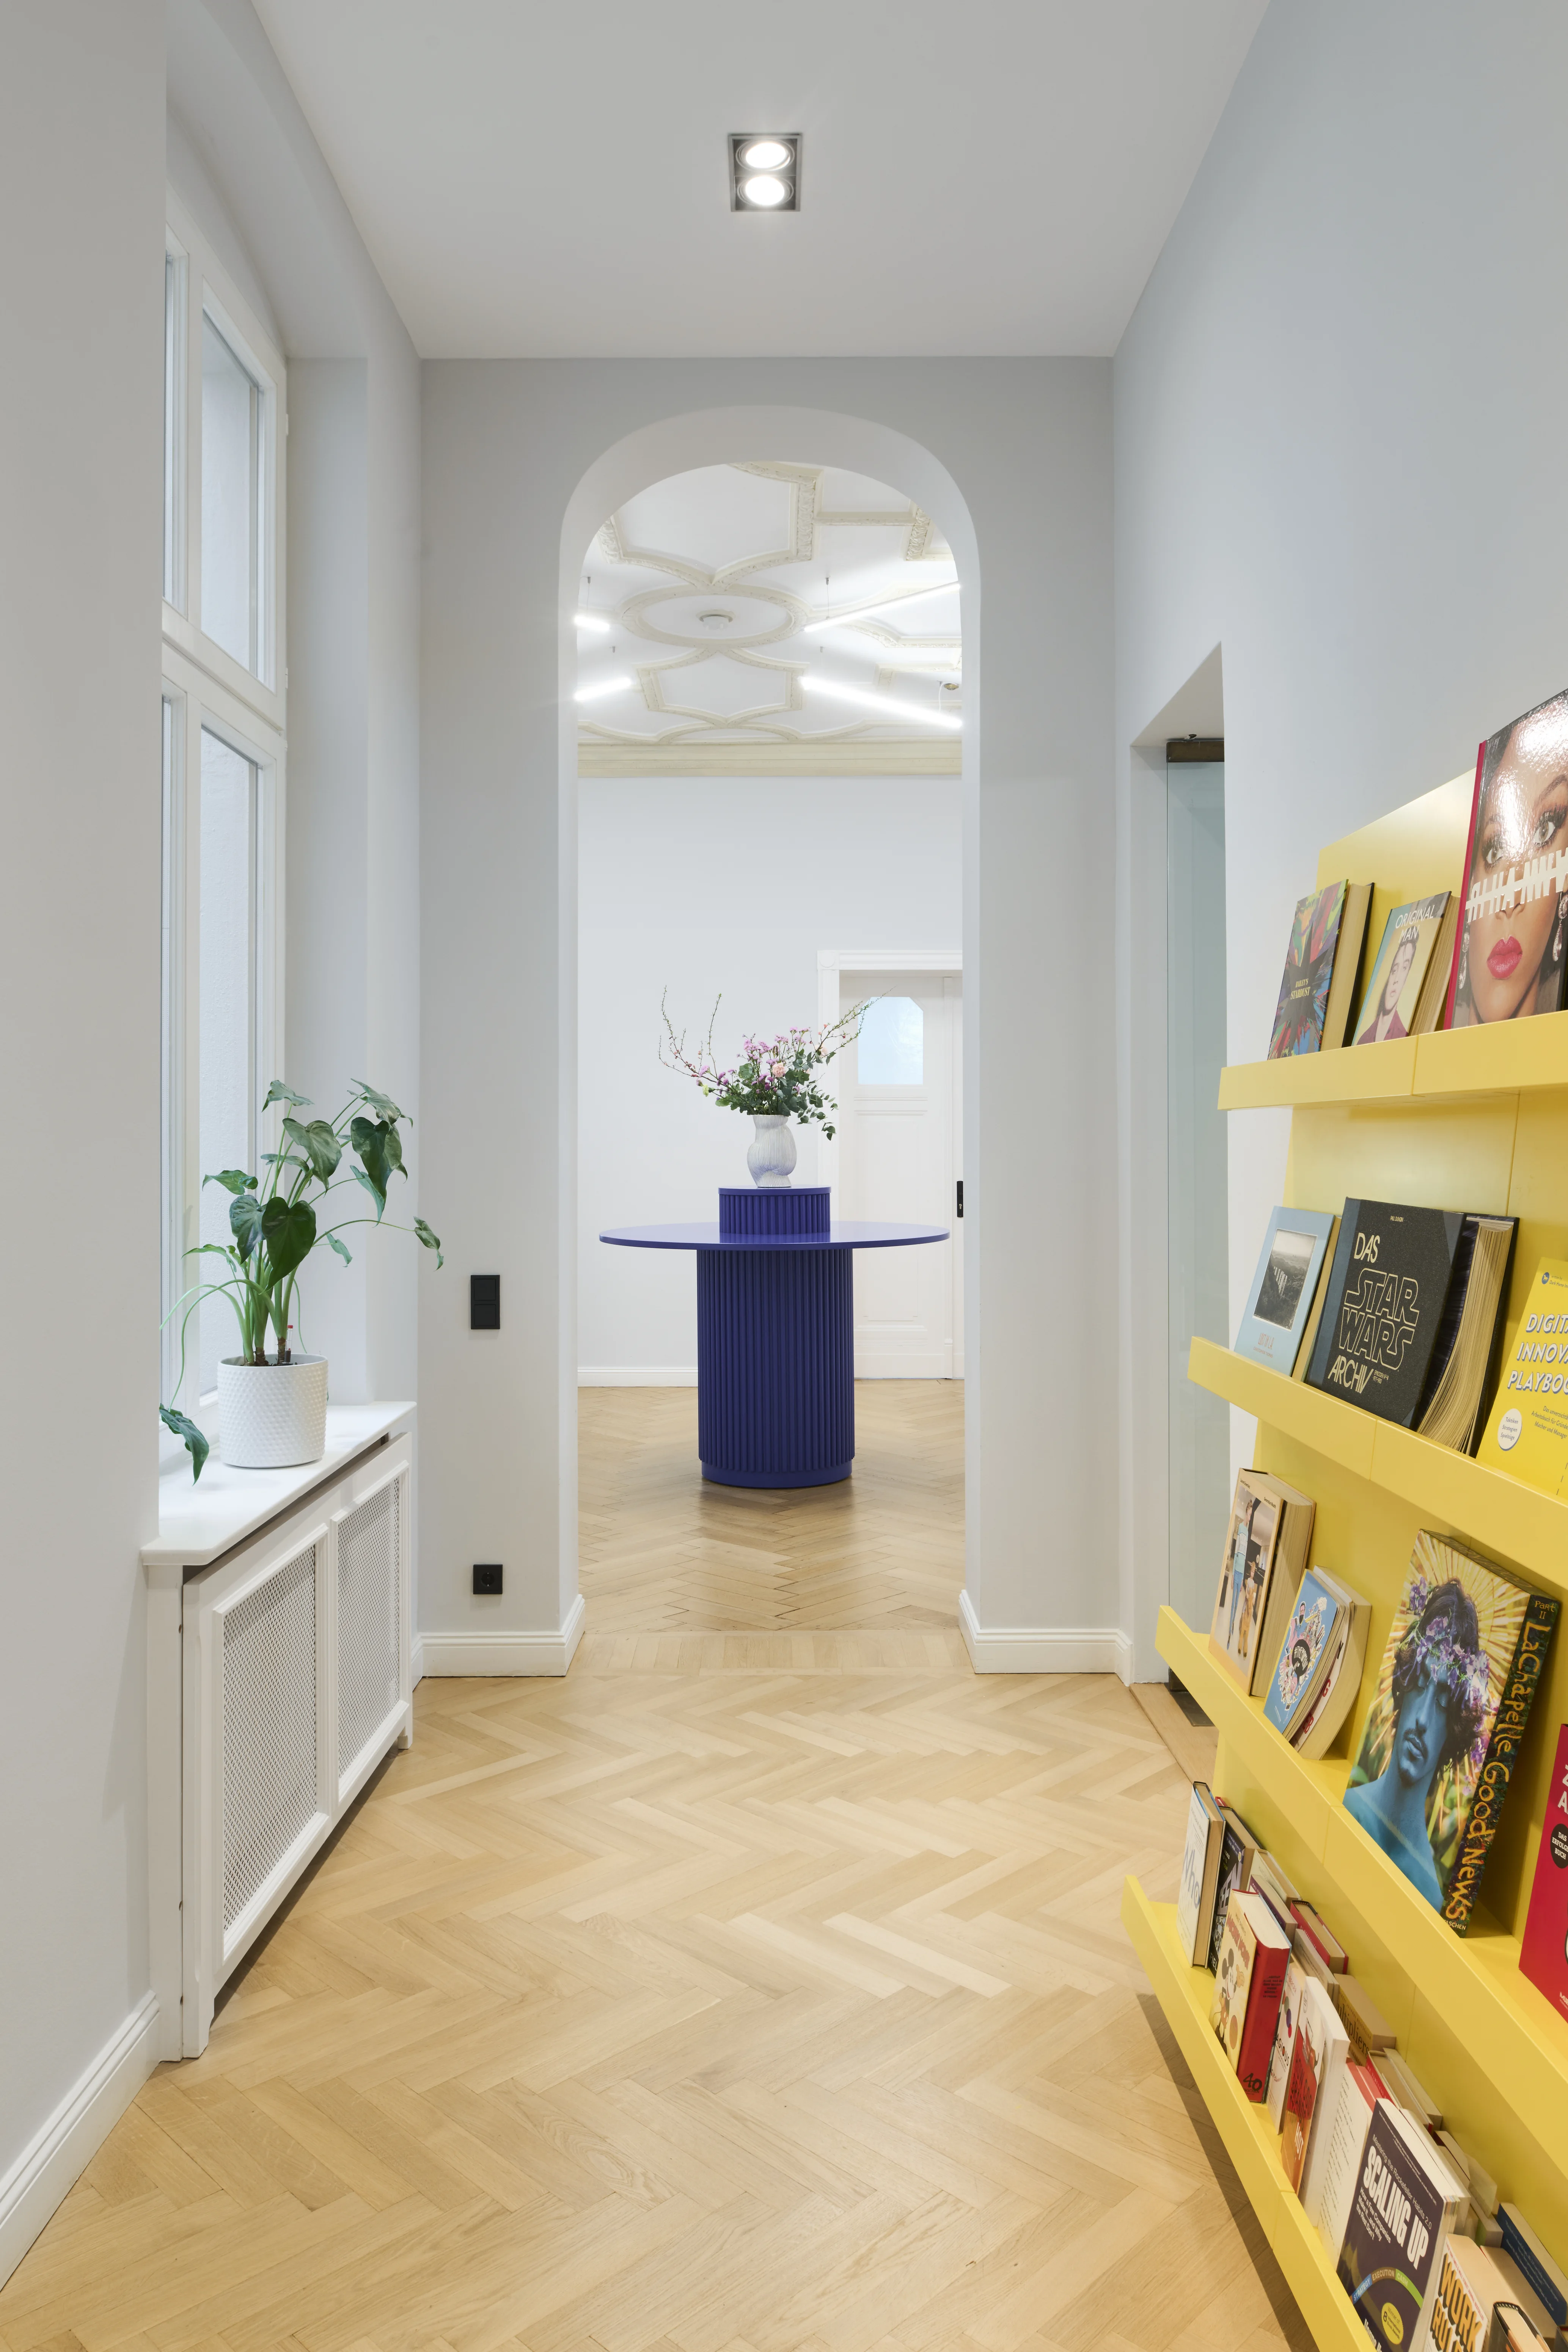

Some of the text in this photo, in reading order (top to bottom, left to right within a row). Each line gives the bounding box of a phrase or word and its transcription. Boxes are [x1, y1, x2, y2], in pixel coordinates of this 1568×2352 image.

[1395, 905, 1435, 929] ORIGINAL
[1398, 924, 1420, 943] MAN
[1295, 978, 1309, 988] BAILEY'S
[1290, 986, 1311, 1000] STARDUST
[1354, 1232, 1380, 1263] DAS
[1344, 1268, 1420, 1327] STAR
[1339, 1307, 1415, 1370] WARS
[1328, 1354, 1374, 1394] ARCHIV
[1374, 1370, 1384, 1379] EPISODEN
[1531, 1410, 1550, 1423] Arbeitsbuch
[1500, 1432, 1515, 1441] Spielzüge
[1502, 1424, 1518, 1433] Strategien
[1534, 1421, 1547, 1430] Macher
[1553, 1428, 1568, 1439] Manager
[1539, 1611, 1546, 1620] II
[1494, 1620, 1551, 1757] LaChapelle
[1467, 1761, 1510, 1840] Good
[1558, 1831, 1567, 1842] DAS
[1554, 1847, 1566, 1860] BUCH
[1243, 2072, 1262, 2091] 40
[1294, 2121, 1304, 2161] HOT
[1372, 2134, 1387, 2163] Mastering
[1392, 2168, 1413, 2201] Rockefeller
[1412, 2197, 1425, 2220] Habits
[1363, 2145, 1411, 2248] SCALING
[1407, 2214, 1429, 2270] UP
[1366, 2224, 1375, 2241] Don't
[1373, 2212, 1391, 2244] Companies
[1373, 2226, 1383, 2242] Why
[1353, 2269, 1409, 2301] STRATEGY EXECUTION CASH
[1438, 2252, 1483, 2352] WORK
[1383, 2311, 1388, 2323] 8
[1387, 2306, 1397, 2321] Winner
[1388, 2316, 1401, 2334] International
